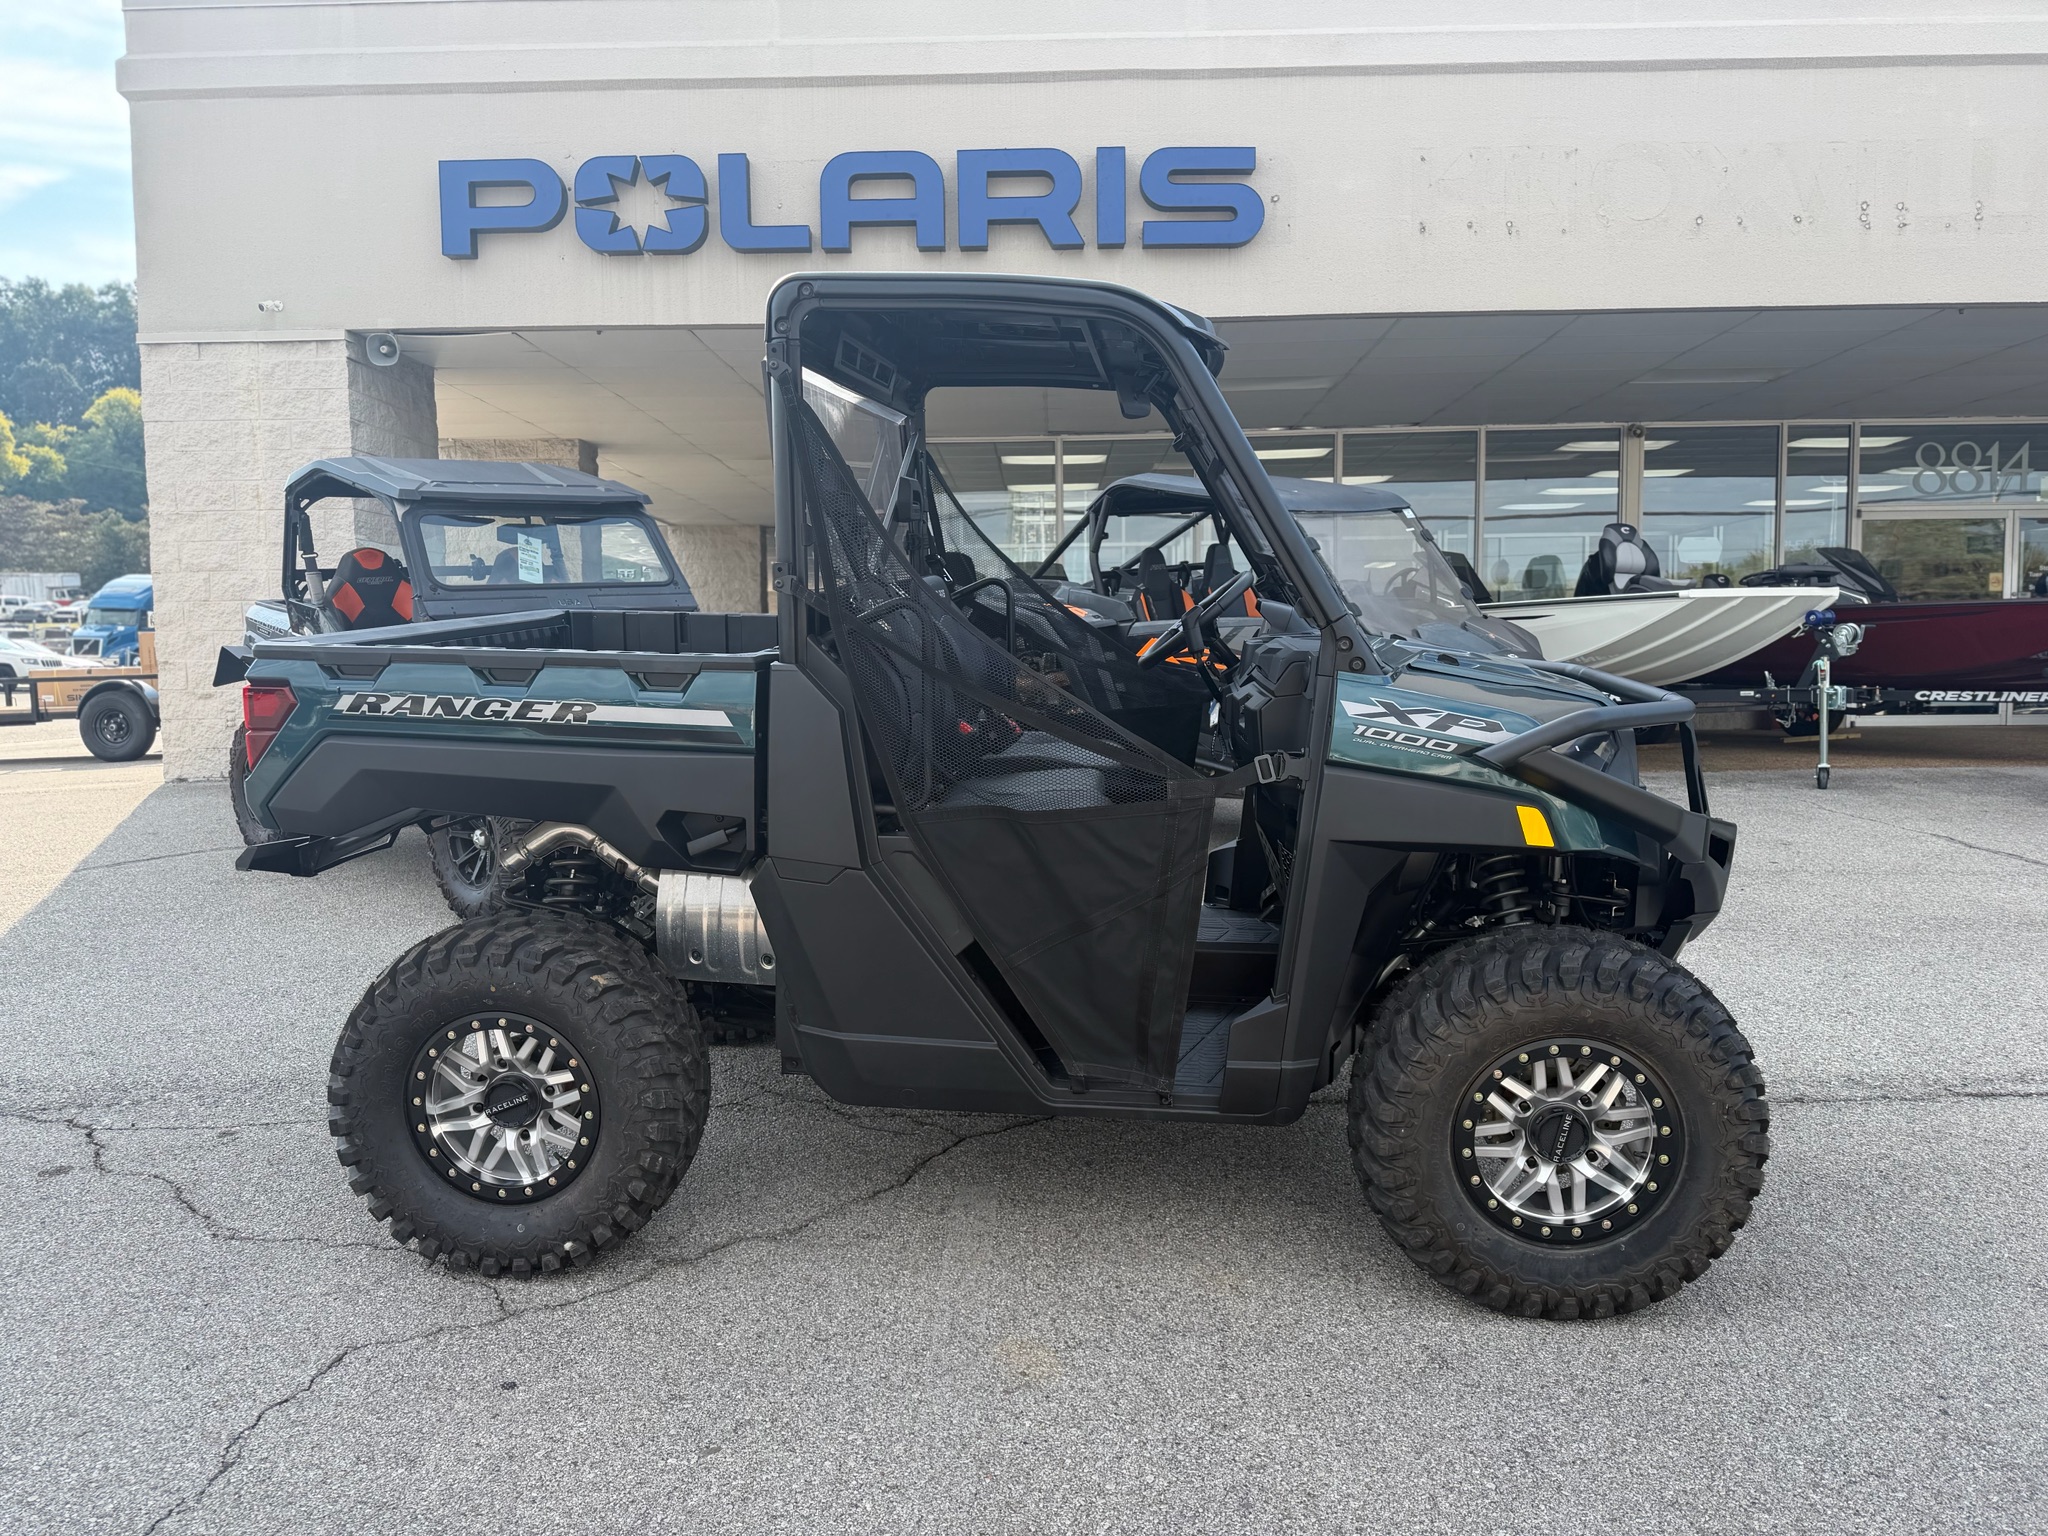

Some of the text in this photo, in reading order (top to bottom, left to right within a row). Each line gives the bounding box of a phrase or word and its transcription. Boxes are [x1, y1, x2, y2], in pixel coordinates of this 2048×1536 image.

[439, 147, 1266, 260] POLARIS
[1912, 440, 2035, 495] 8814
[343, 692, 597, 725] RANGER
[1350, 697, 1507, 733] XP
[1352, 737, 1378, 747] DUAL
[1379, 742, 1431, 757] OVERHEAD
[1353, 724, 1458, 753] 1000
[485, 1093, 529, 1117] RACELINE
[1552, 1113, 1574, 1163] RACELINE
